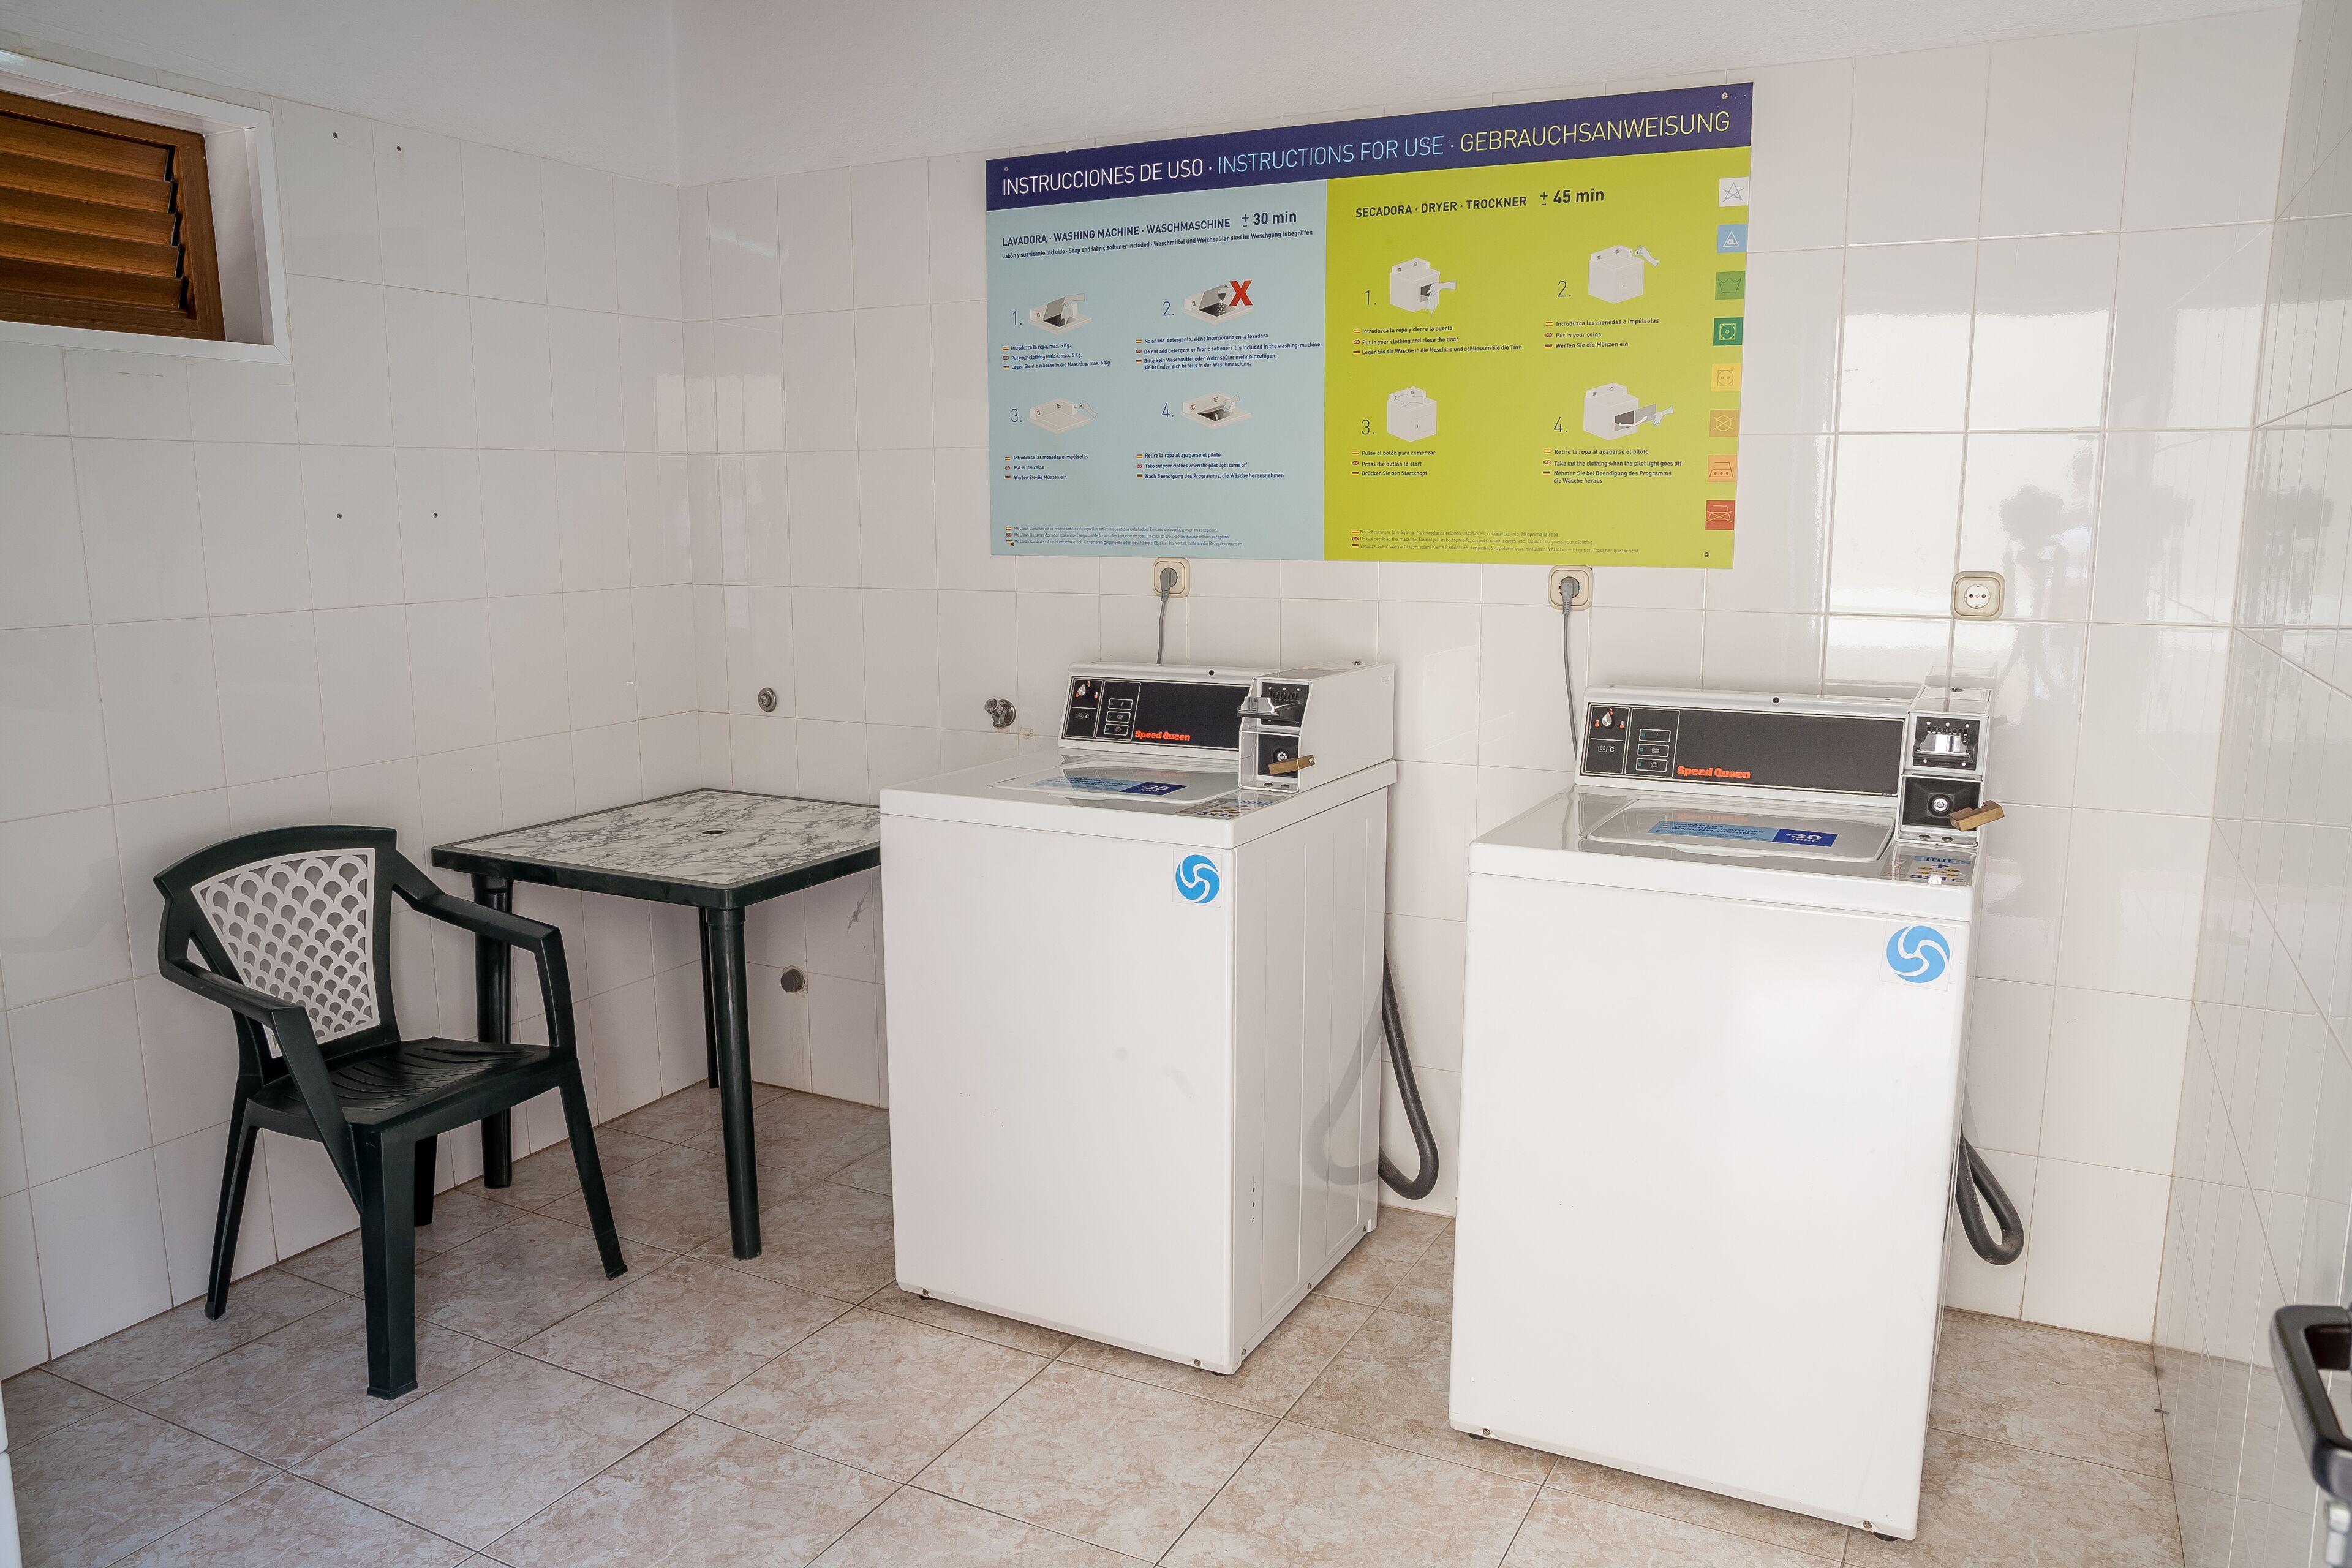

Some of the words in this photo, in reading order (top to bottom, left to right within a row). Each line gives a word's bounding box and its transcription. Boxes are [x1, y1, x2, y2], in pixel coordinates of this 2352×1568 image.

[1003, 165, 1134, 196] INSTRUCCIONES
[1140, 162, 1163, 182] DE
[1168, 158, 1202, 179] USO
[1218, 144, 1354, 174] INSTRUCTIONS
[1360, 140, 1398, 161] FOR
[1405, 135, 1444, 157] USE
[1461, 111, 1729, 152] GEBRAUCHSANWEISUNG
[1553, 189, 1570, 203] 45
[1575, 188, 1604, 202] min
[1355, 204, 1412, 217] SECADORA
[1421, 201, 1457, 213] DRYER
[1466, 196, 1526, 210] TROCKNER
[1253, 212, 1268, 225] 30
[1272, 210, 1296, 224] min
[1003, 234, 1047, 246] LAVADORA
[1054, 230, 1095, 242] WASHING
[1098, 225, 1139, 238] MACHINE
[1146, 218, 1230, 234] WASCHMASCHINE
[1557, 281, 1571, 297] 2.
[1365, 290, 1377, 305] 1.
[1163, 301, 1174, 316] 2.
[1012, 311, 1022, 325] 1.
[1011, 409, 1022, 423] 3.
[1162, 403, 1174, 418] 4.
[1361, 420, 1374, 435] 3.
[1553, 417, 1568, 432] 4.
[1134, 730, 1161, 739] Speed
[1163, 731, 1191, 741] Queen
[1677, 766, 1713, 777] Speed
[1714, 768, 1751, 779] Queen
